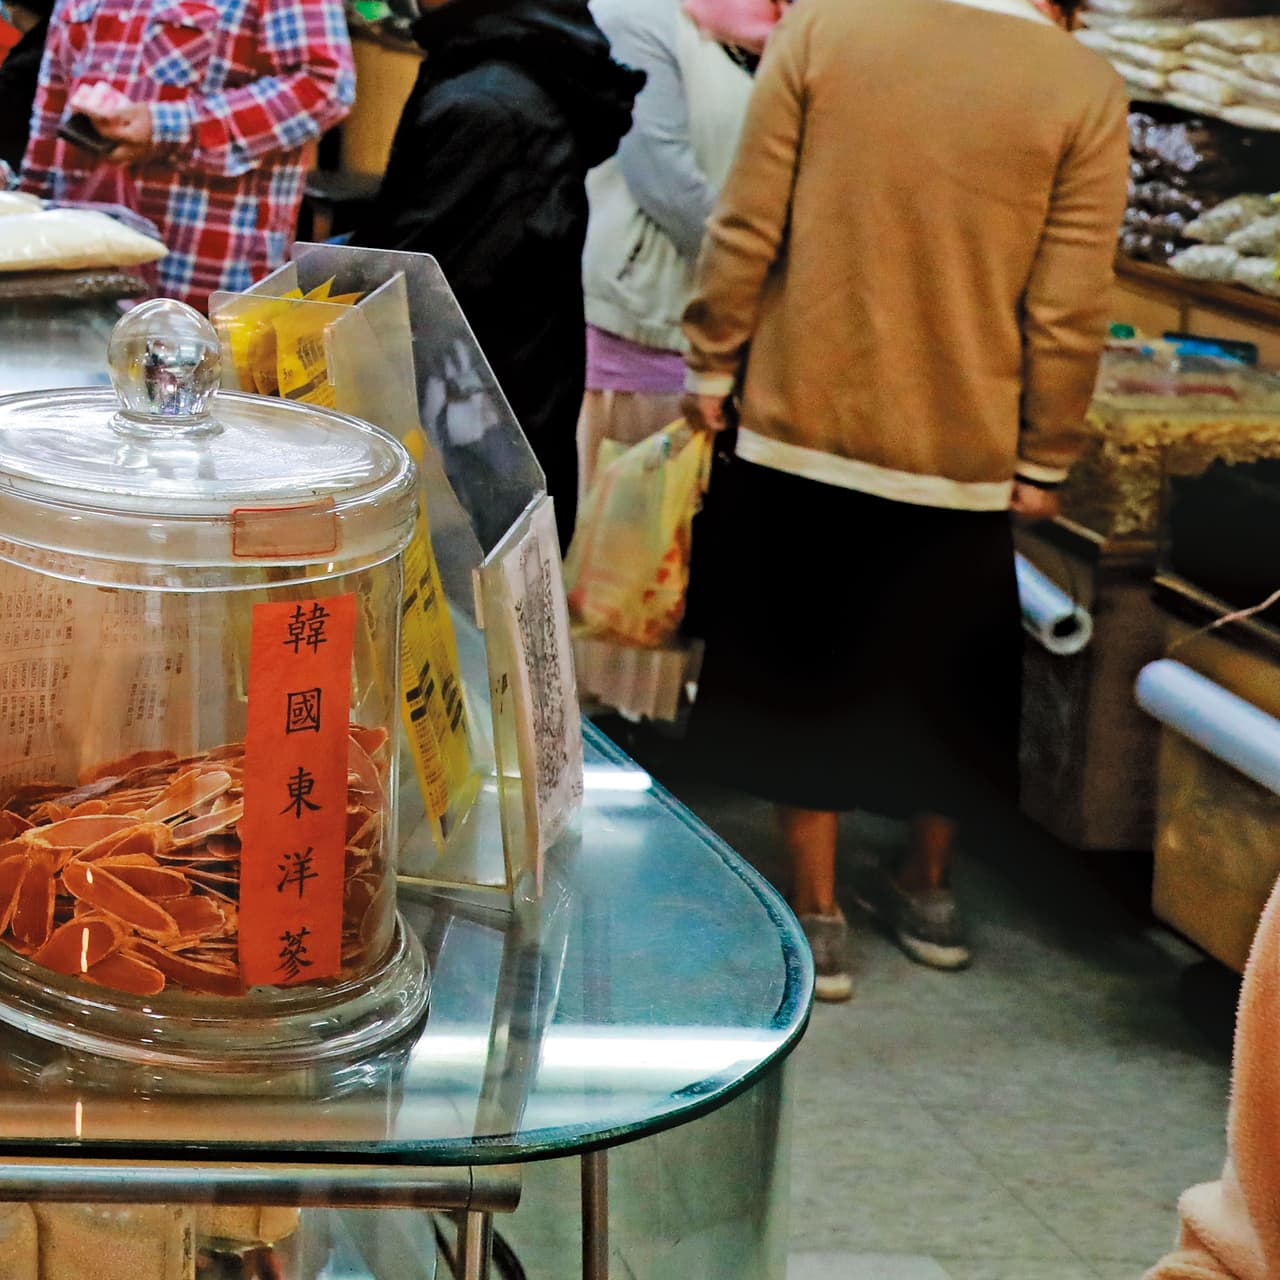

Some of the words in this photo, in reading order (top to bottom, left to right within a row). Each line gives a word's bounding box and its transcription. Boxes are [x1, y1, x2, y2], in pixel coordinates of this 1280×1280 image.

[274, 602, 331, 981] 韓國東洋蔘
